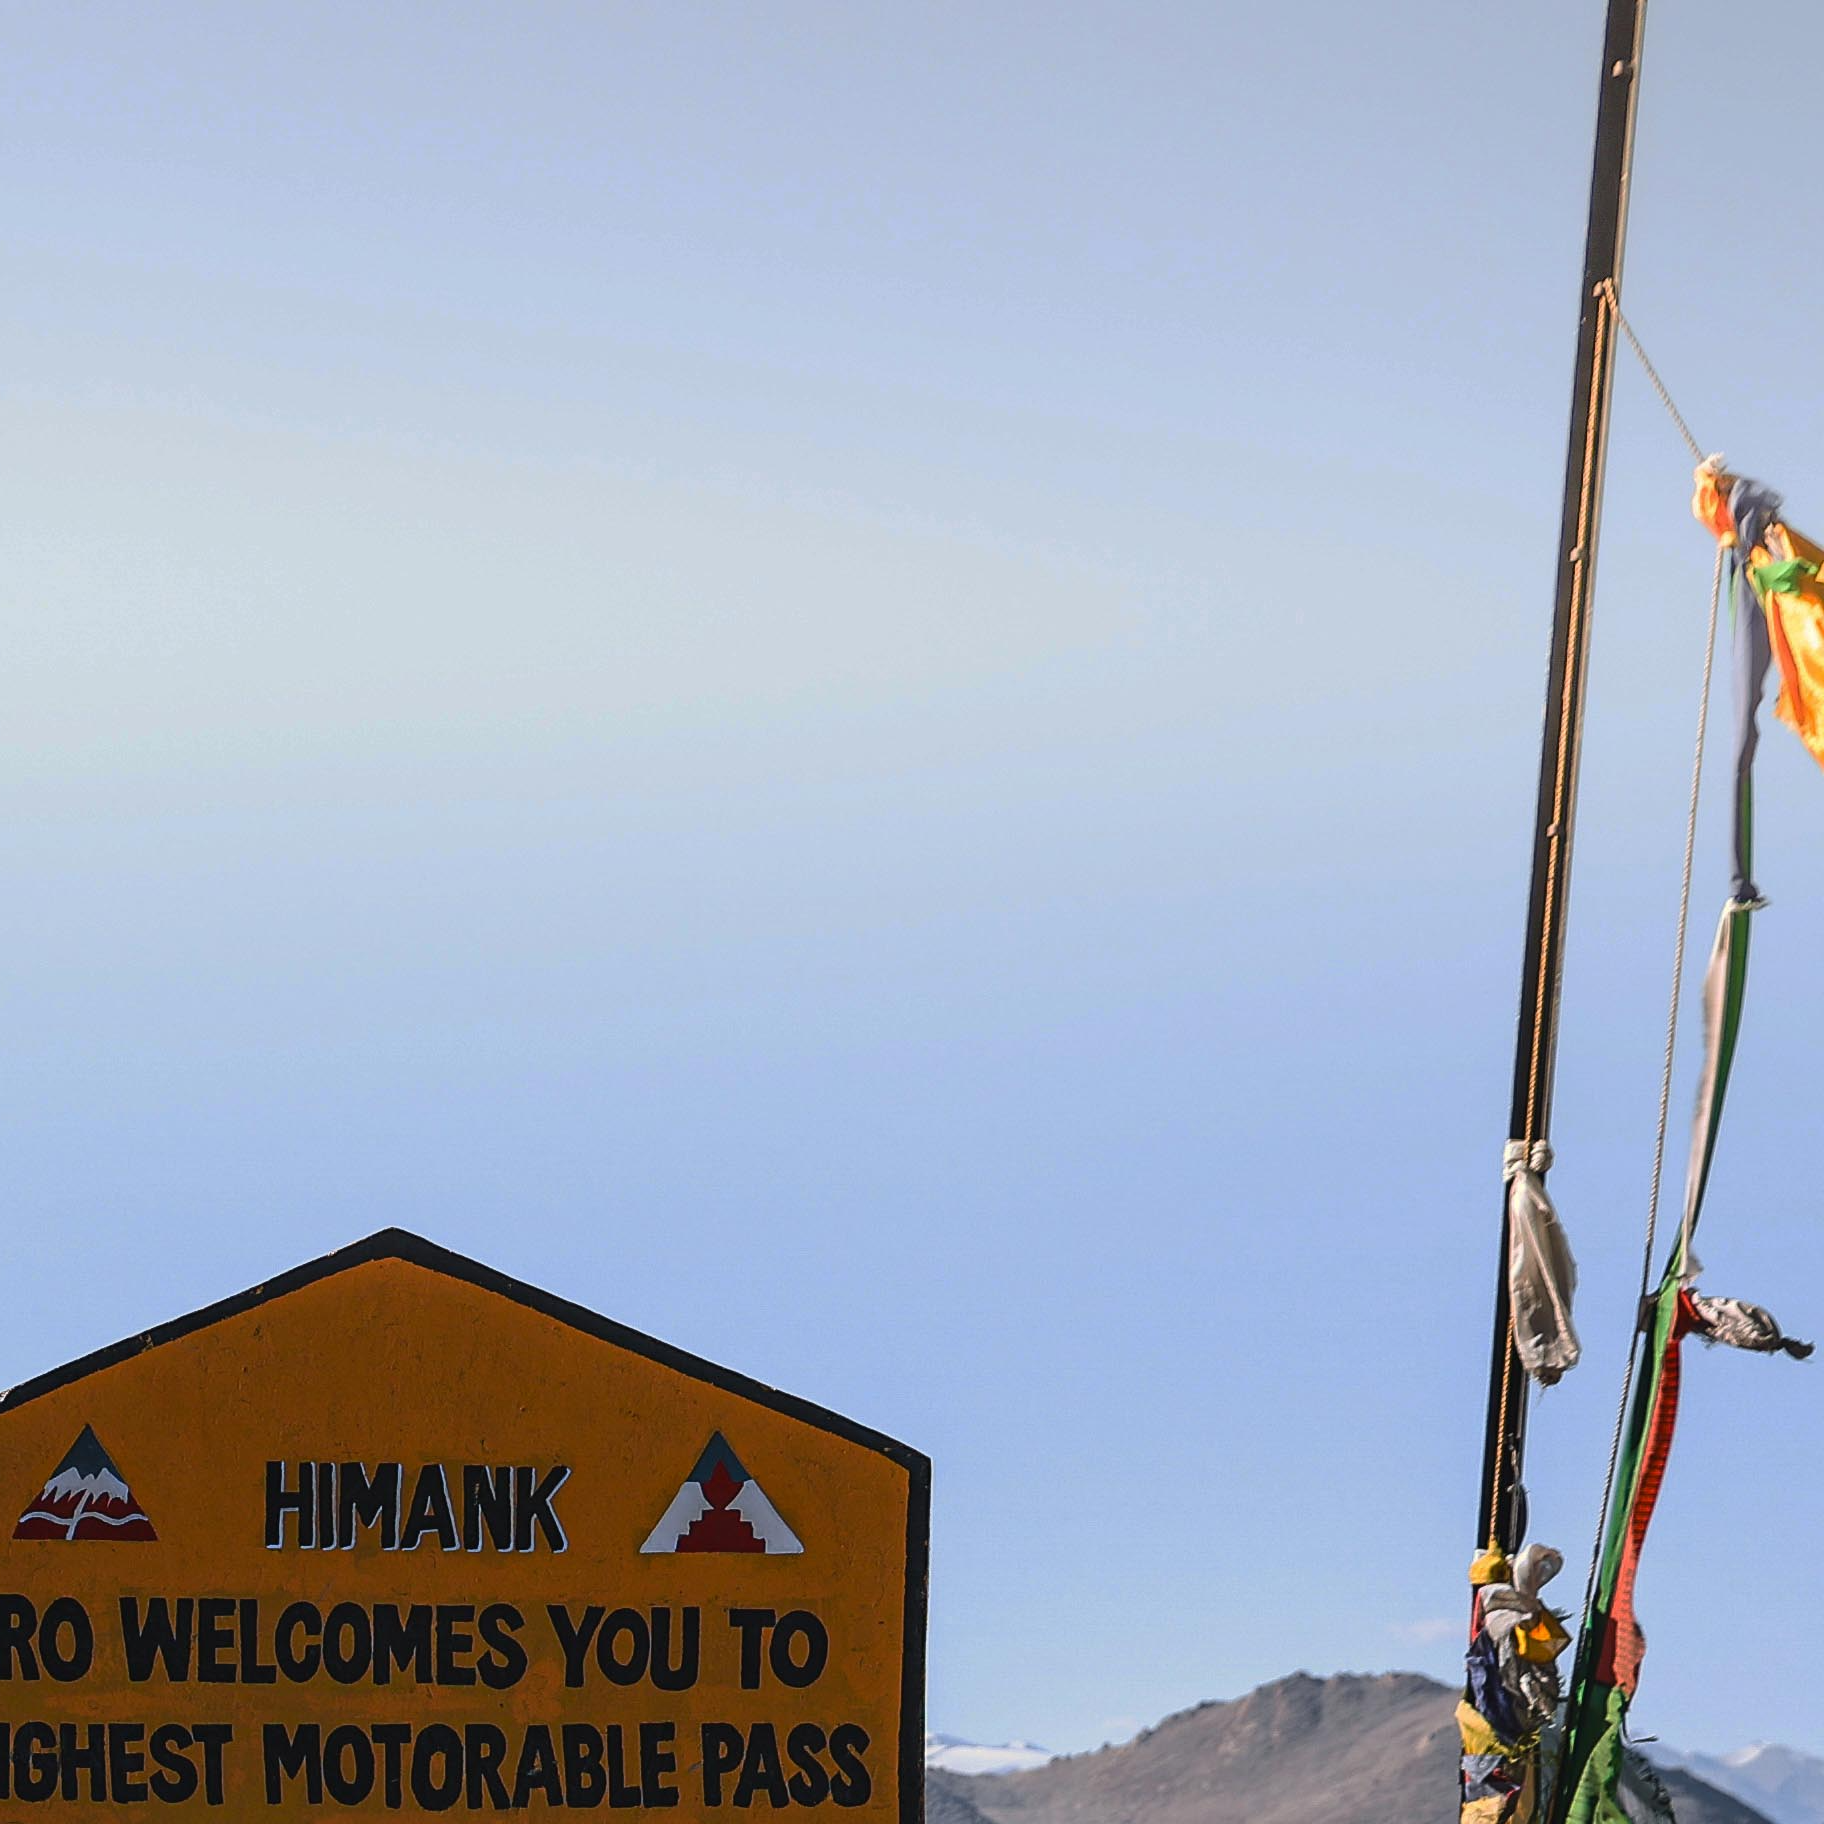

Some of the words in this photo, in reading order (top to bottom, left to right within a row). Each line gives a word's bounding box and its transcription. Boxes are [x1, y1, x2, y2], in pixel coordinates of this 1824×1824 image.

[265, 1459, 573, 1554] HIMANK
[119, 1597, 528, 1690] WELCOMES
[547, 1604, 701, 1691] YOU
[724, 1607, 829, 1690] TO
[263, 1721, 679, 1812] MOTORABLE
[703, 1722, 872, 1808] PASS
